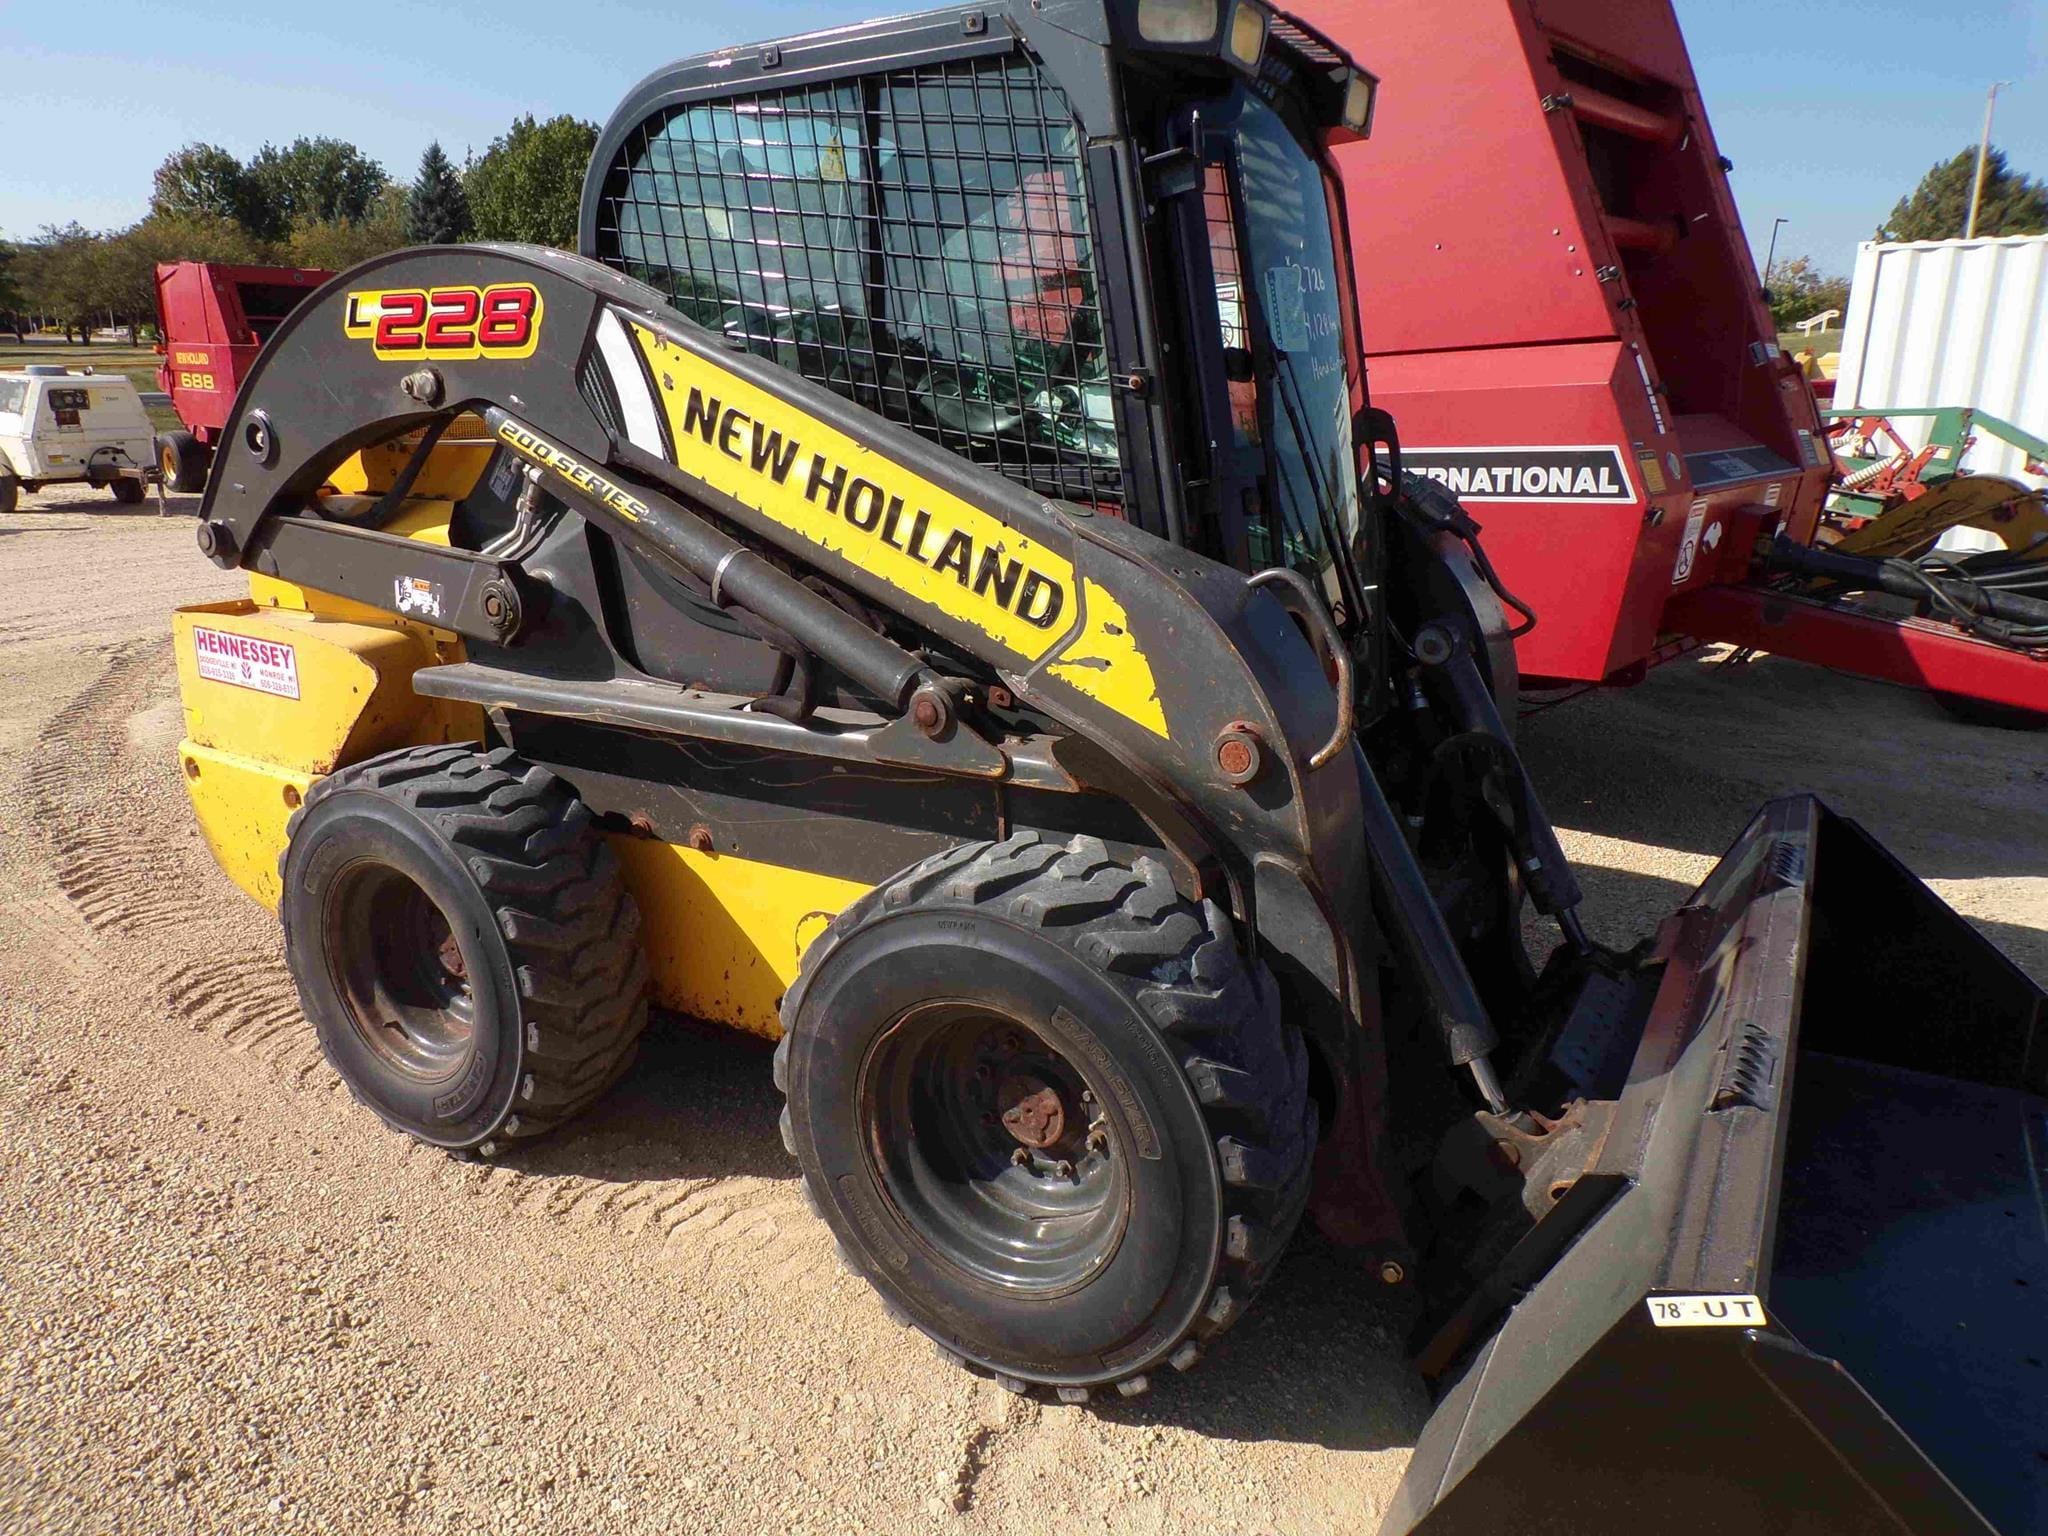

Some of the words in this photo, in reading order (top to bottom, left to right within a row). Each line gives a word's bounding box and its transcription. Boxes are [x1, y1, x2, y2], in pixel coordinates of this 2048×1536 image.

[347, 288, 537, 350] L228
[181, 372, 214, 389] 688
[501, 422, 552, 459] 200
[553, 456, 648, 516] SERIES
[1402, 467, 1619, 493] RNATIONAL
[682, 386, 800, 486] NEW
[804, 453, 1064, 630] HOLLAND
[197, 630, 290, 669] HENNESSEY
[260, 669, 285, 682] MONROE
